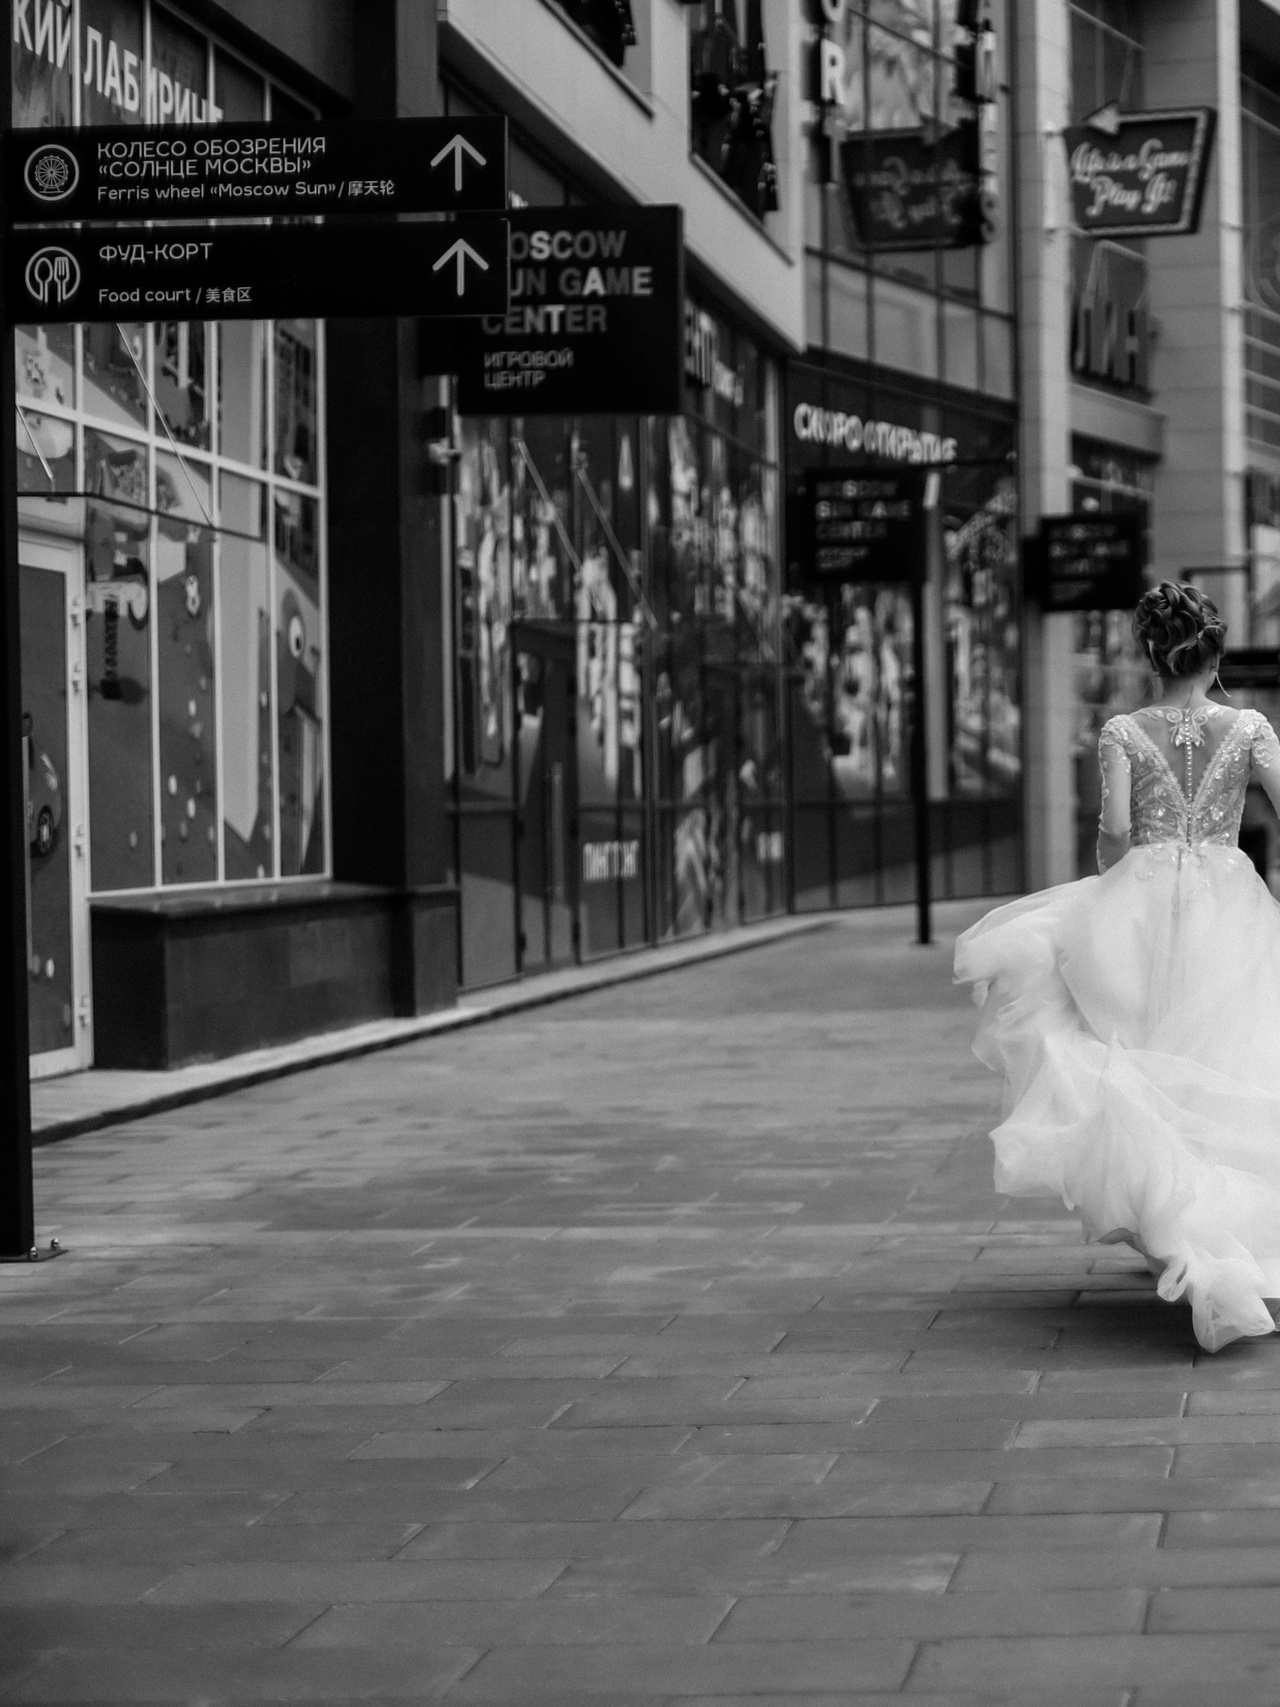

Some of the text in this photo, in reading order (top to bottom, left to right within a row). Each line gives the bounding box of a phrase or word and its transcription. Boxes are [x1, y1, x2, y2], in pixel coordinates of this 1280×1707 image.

[97, 137, 326, 159] КОЛЕСО ОБОЗРЕНИЯ
[98, 156, 312, 178] «СОЛНЦЕ МОСКВЫ»
[97, 185, 150, 200] Ferris
[155, 183, 205, 198] wheel
[210, 182, 290, 197] «Moscow
[98, 242, 213, 263] ФУД-КОРТ
[510, 230, 627, 261] OSCOW
[510, 266, 653, 296] UN GAME
[98, 287, 140, 303] Food
[145, 287, 191, 302] court
[205, 287, 252, 303] 美食区
[484, 370, 546, 390] ЦЕНТР
